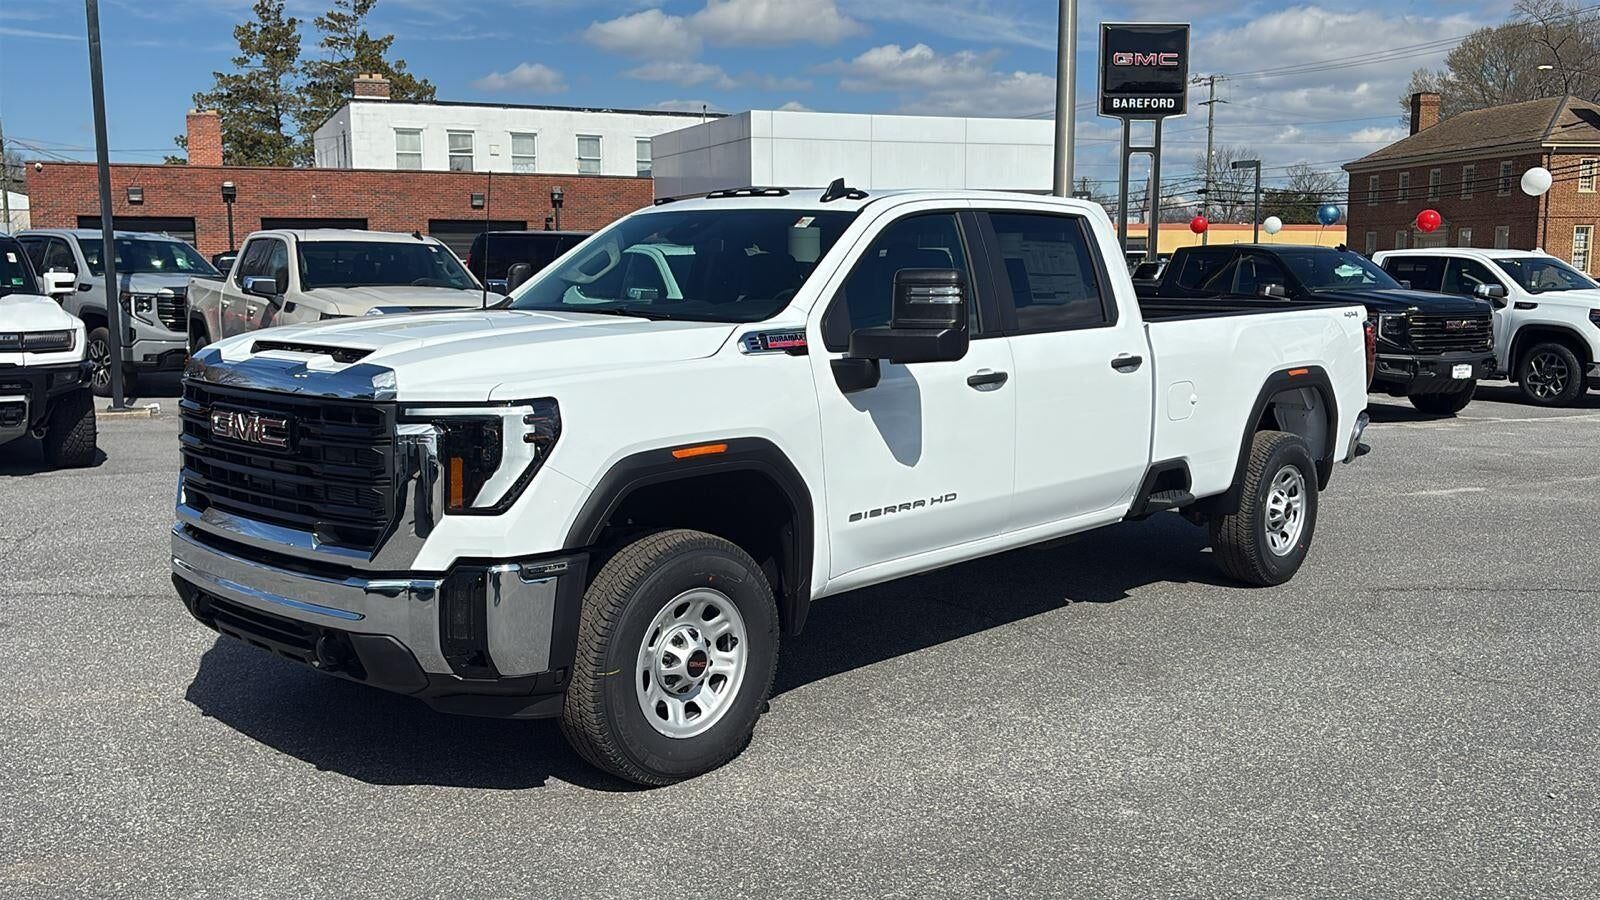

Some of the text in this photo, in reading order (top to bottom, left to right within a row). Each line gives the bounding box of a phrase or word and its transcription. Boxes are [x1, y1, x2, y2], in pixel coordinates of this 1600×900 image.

[1113, 52, 1178, 66] GMC
[1113, 98, 1175, 109] BAREFORD
[769, 334, 804, 342] DURAMAX
[211, 410, 287, 447] GMC
[849, 492, 957, 522] SIERRA HD
